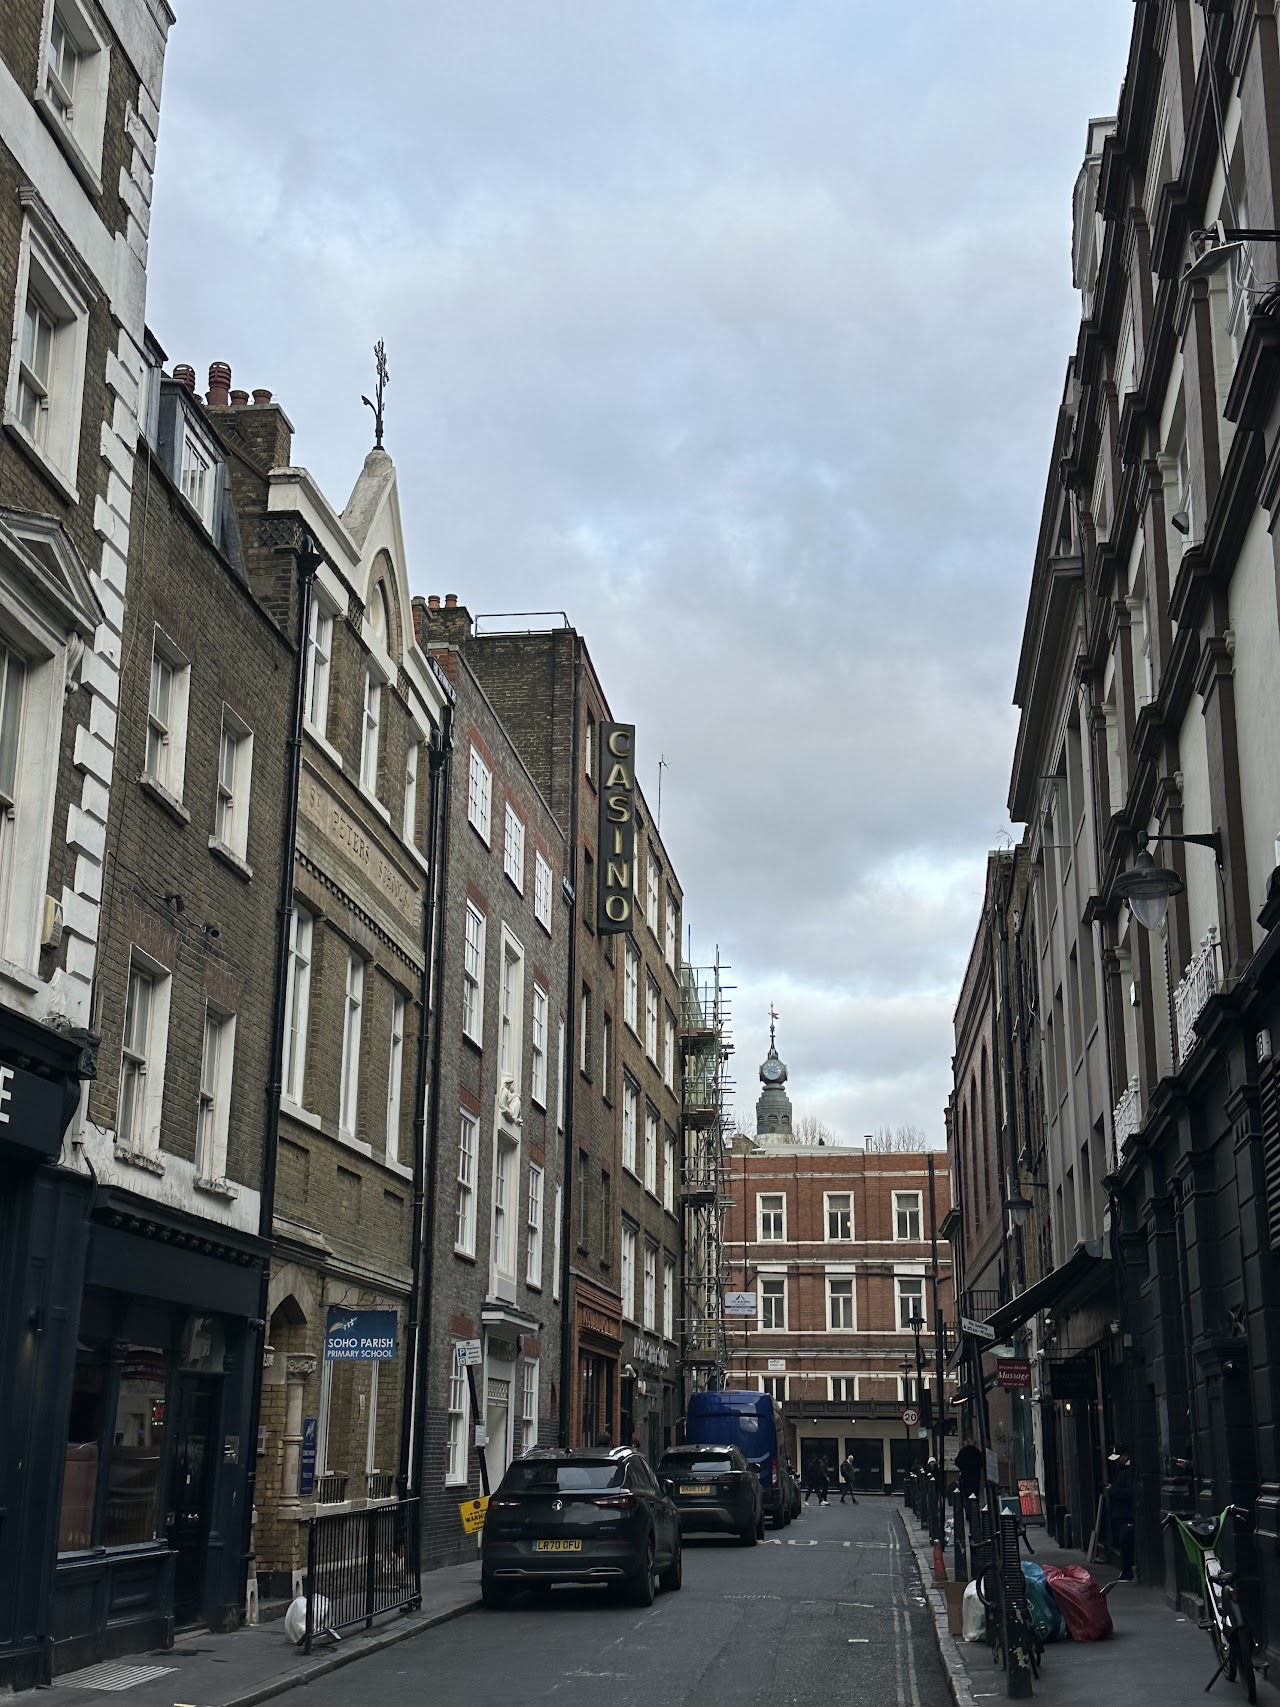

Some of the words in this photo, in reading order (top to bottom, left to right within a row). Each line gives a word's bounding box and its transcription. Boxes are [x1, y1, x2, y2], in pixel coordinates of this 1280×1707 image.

[604, 730, 634, 922] CASINO
[328, 1338, 358, 1348] SOHO
[360, 1338, 394, 1348] PARISH
[327, 1350, 359, 1358] PRIMARY
[361, 1350, 393, 1358] SCHOOL
[997, 1370, 1029, 1381] Massage
[904, 1413, 917, 1421] 20
[537, 1541, 560, 1549] LR70
[562, 1541, 580, 1549] OFU
